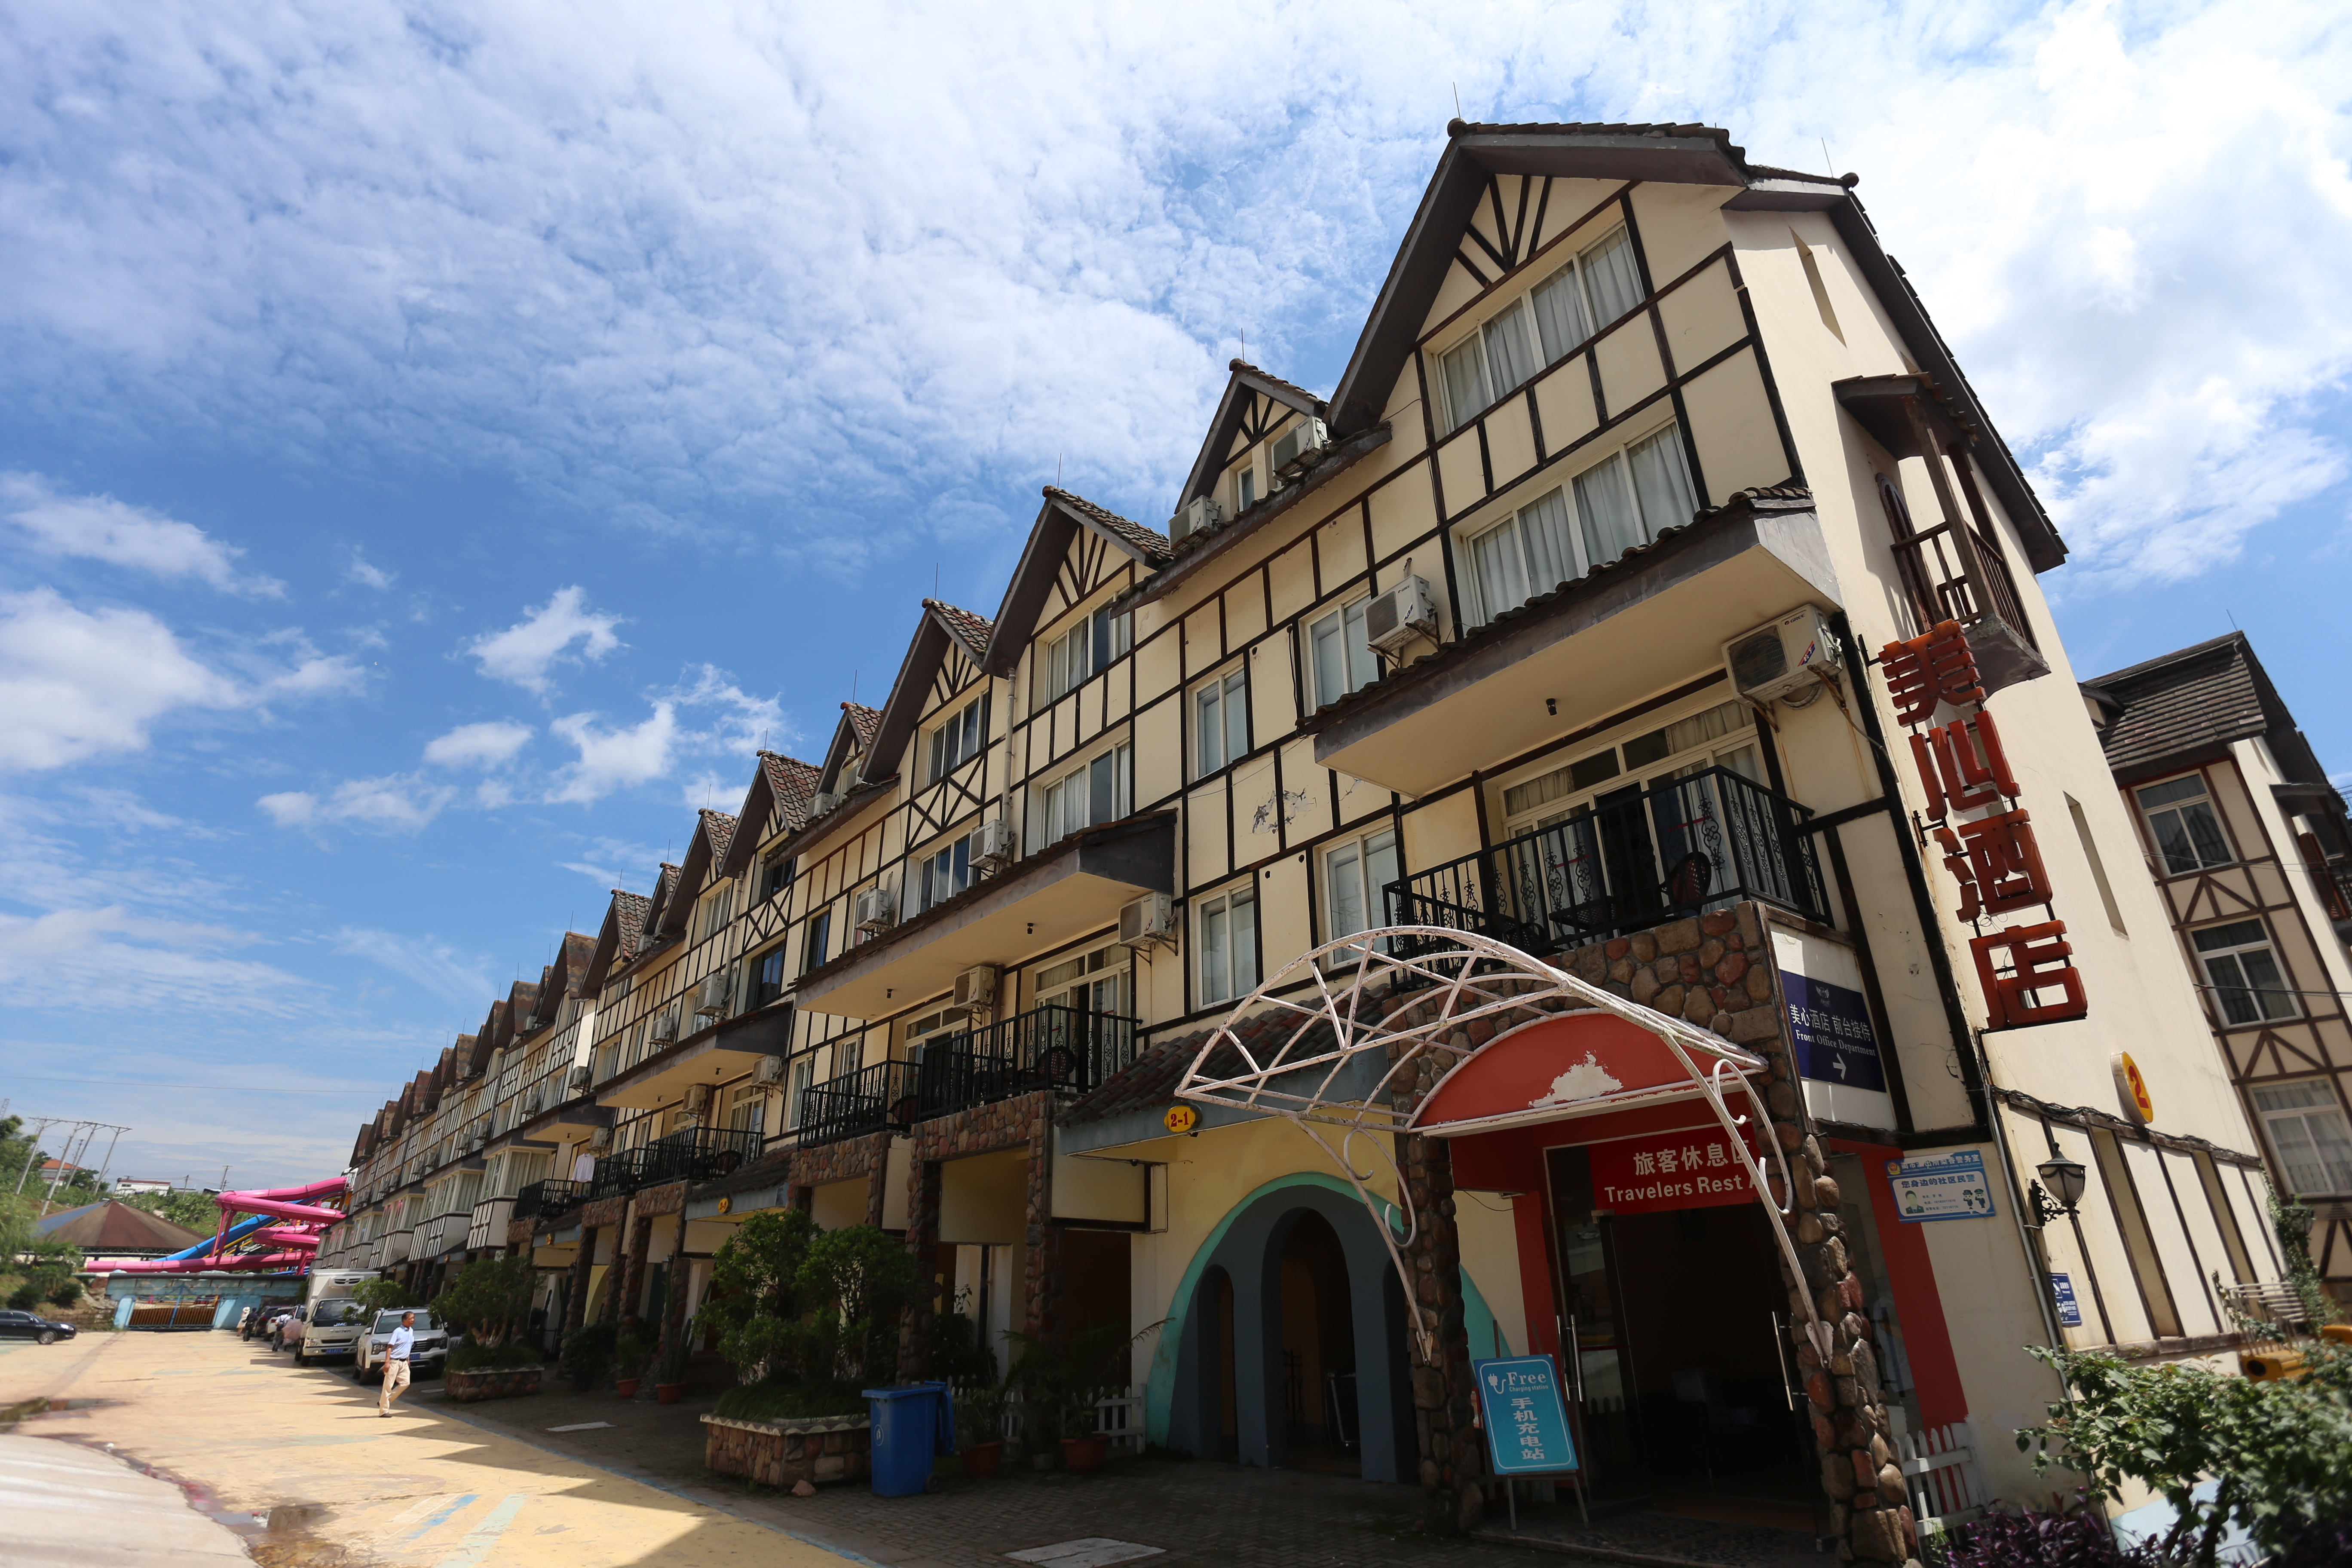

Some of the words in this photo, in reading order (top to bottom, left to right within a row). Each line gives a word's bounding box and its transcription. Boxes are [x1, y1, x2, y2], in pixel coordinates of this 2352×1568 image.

[1790, 613, 1805, 623] GREE
[1878, 618, 2088, 1030] 美心酒店
[1790, 1004, 1831, 1032] 美心酒店
[1831, 1015, 1871, 1041] 前台接待
[1795, 1029, 1815, 1043] Front
[1816, 1035, 1837, 1047] Office
[1838, 1039, 1876, 1056] Department
[2128, 1065, 2149, 1109] 2
[1170, 1111, 1189, 1127] 2-1
[1605, 1182, 1693, 1202] Travelers
[1697, 1175, 1743, 1193] Rest
[1901, 1174, 1975, 1188] 您身边的社区民警
[1506, 1372, 1547, 1385] Free
[1510, 1397, 1545, 1460] 手机充电站
